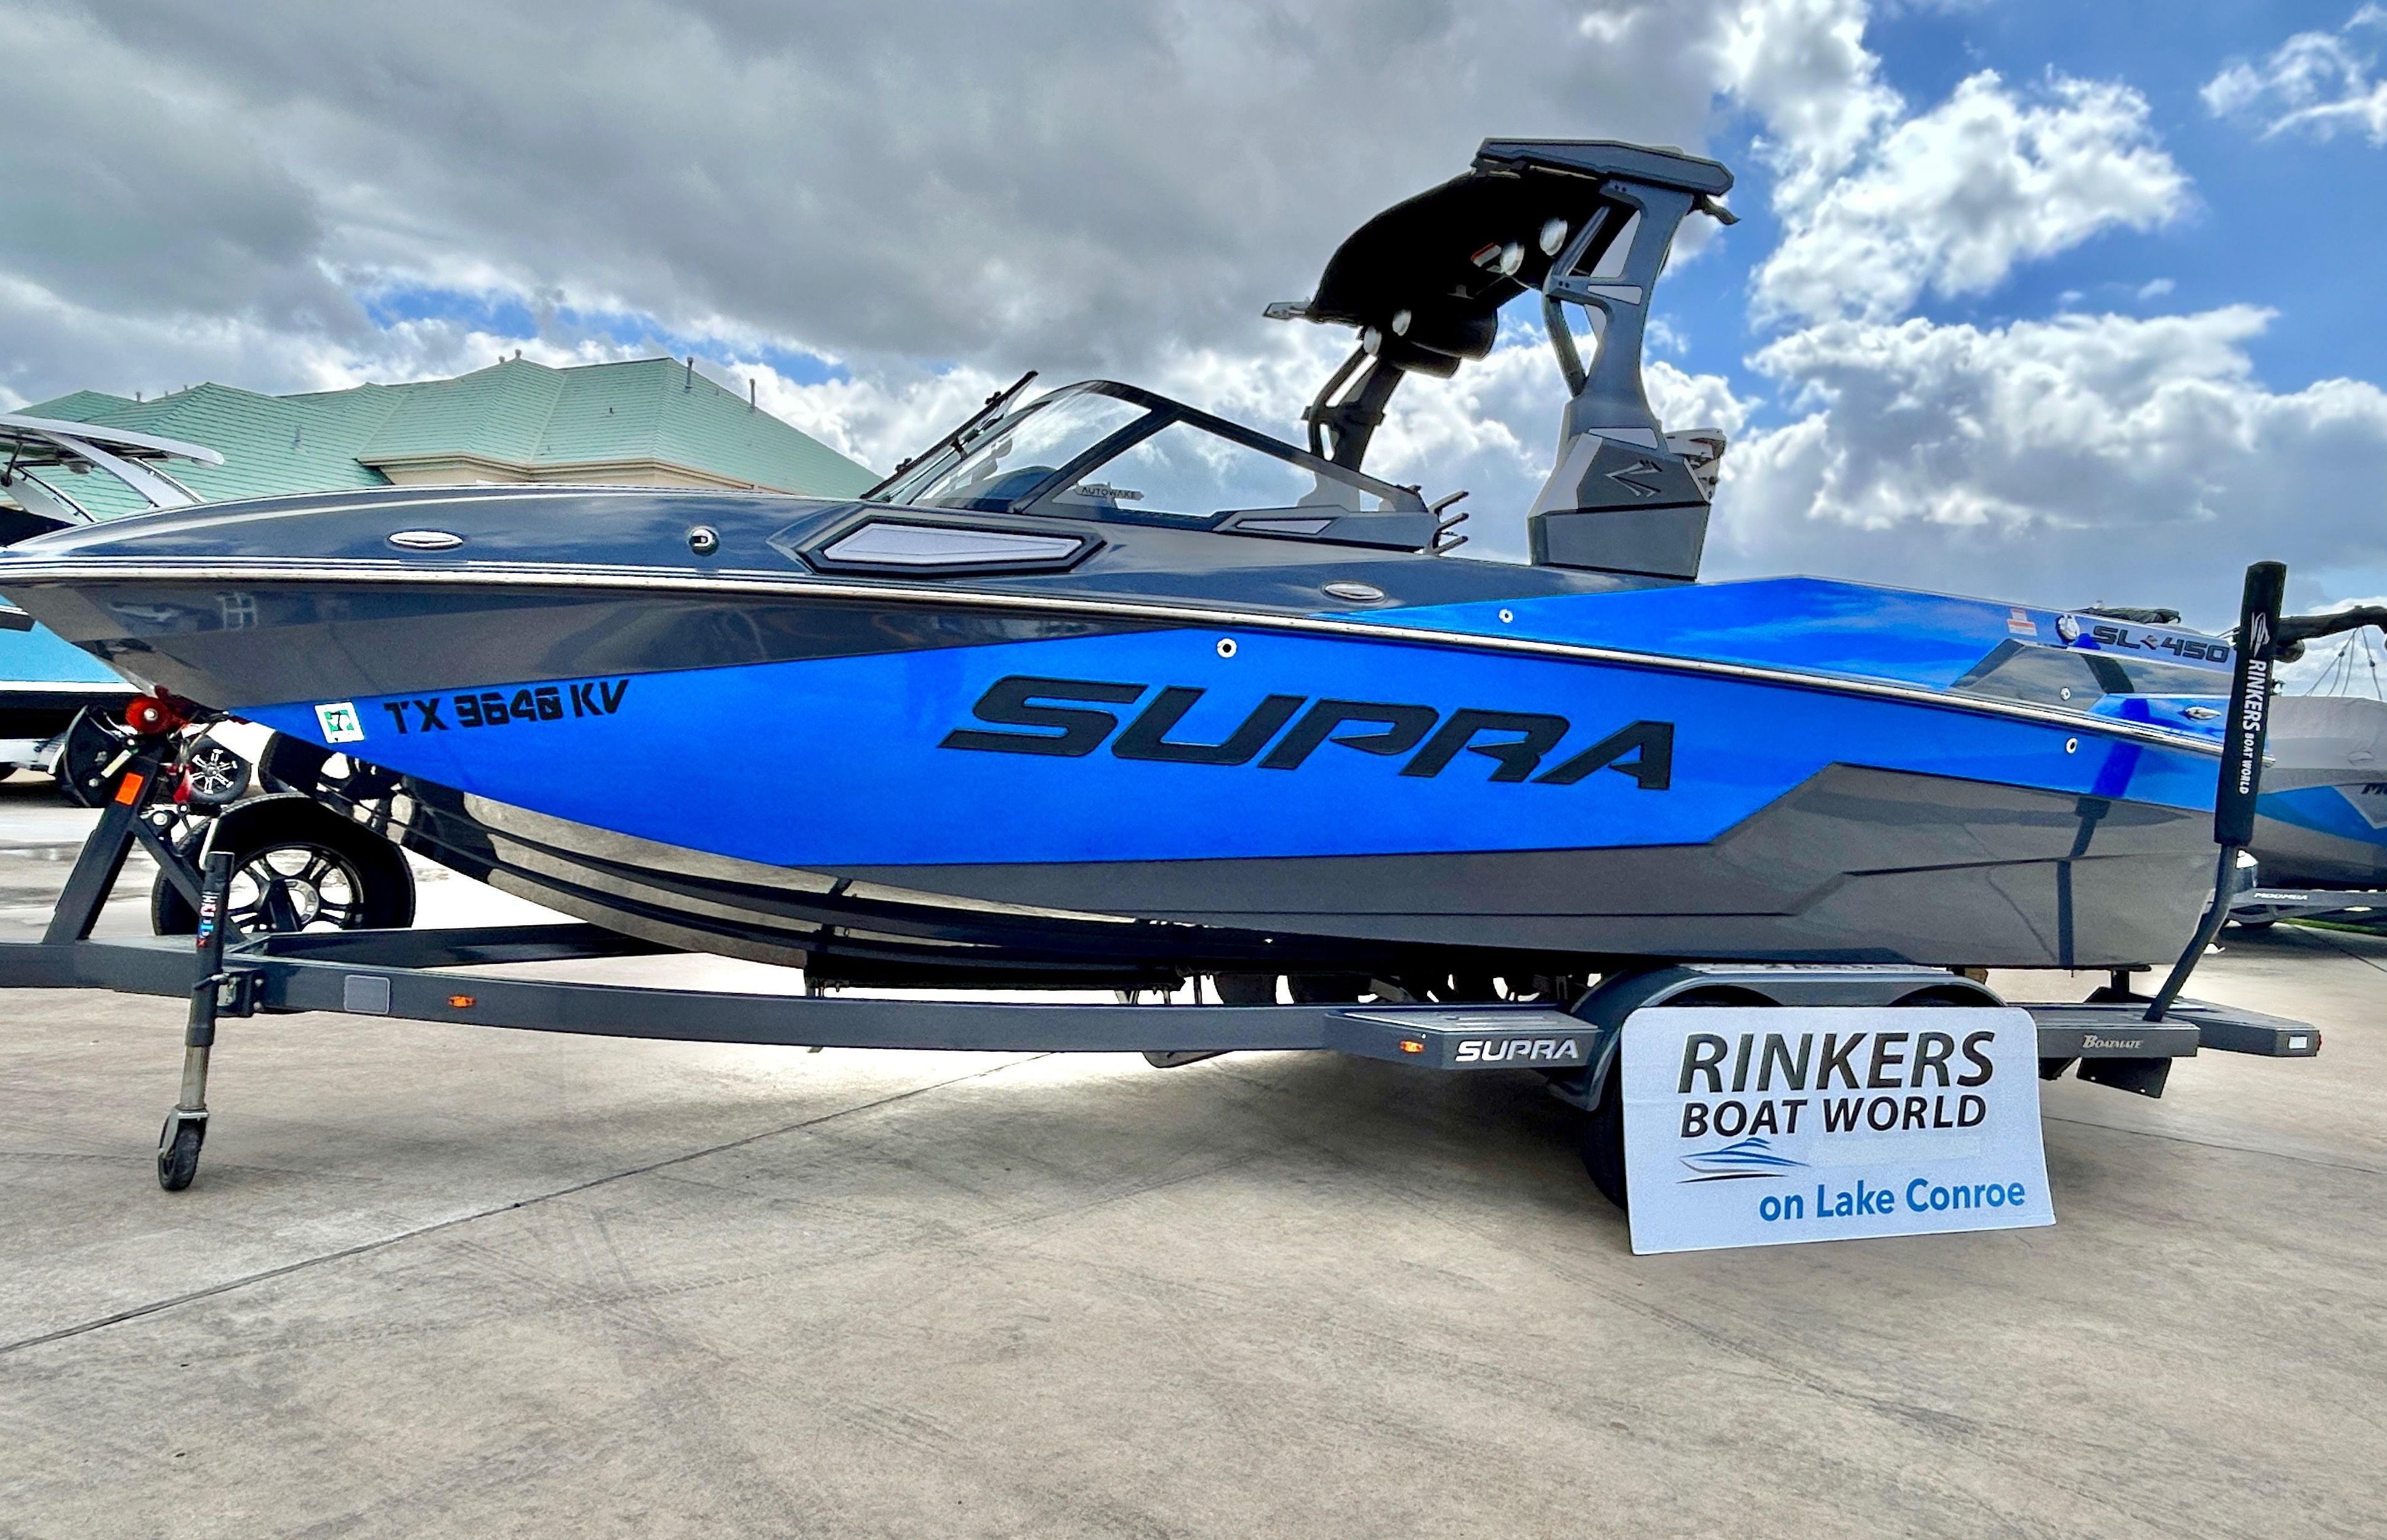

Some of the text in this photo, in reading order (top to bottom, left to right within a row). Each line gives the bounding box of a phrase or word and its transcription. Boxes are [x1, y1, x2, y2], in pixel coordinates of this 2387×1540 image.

[1082, 486, 1137, 499] AUTOWAKE
[2093, 625, 2230, 664] SL 450
[383, 697, 450, 735] TX
[570, 679, 630, 718] KV
[2239, 658, 2267, 795] RINKERS BOAT WORLD
[939, 675, 1675, 790] SUPRA
[1455, 1039, 1579, 1062] SUPRA
[1677, 1031, 1995, 1094] RINKERS
[1680, 1094, 1987, 1139] BOAT WORLD
[1759, 1178, 2026, 1221] on Lake Conroe
